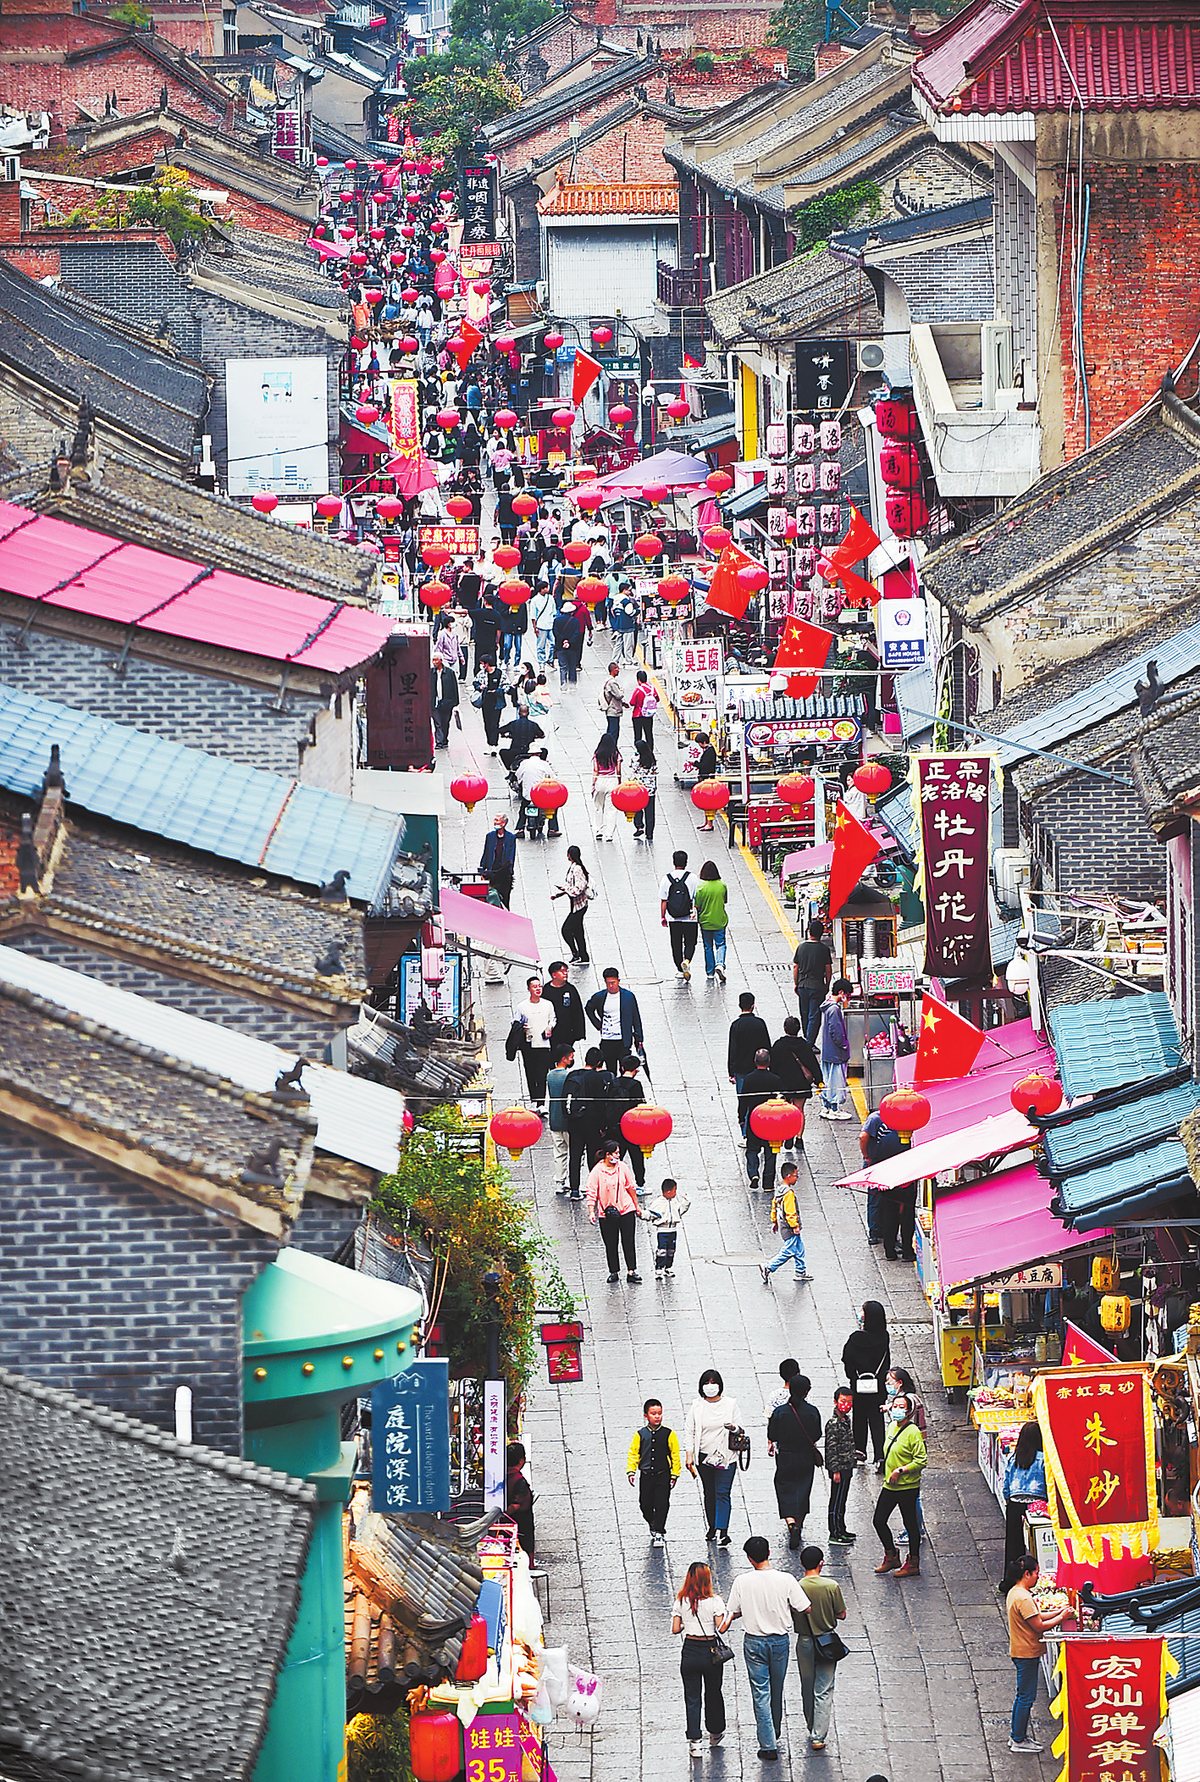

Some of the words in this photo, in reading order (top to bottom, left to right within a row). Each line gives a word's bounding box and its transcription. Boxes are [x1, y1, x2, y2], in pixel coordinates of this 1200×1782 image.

[645, 605, 689, 619] 臭豆腐
[675, 649, 683, 674] 长沙
[685, 647, 719, 673] 臭豆腐
[925, 761, 983, 781] 正宗
[1101, 1264, 1111, 1288] 起名
[1114, 1303, 1124, 1327] 起名
[1055, 1380, 1135, 1400] 赤虹灵砂
[425, 1403, 434, 1421] The
[384, 1404, 412, 1507] 庭院深深
[426, 1442, 434, 1450] is
[424, 1450, 435, 1479] deeply
[1083, 1411, 1121, 1511] 朱砂
[424, 1480, 435, 1505] depth
[1085, 1655, 1147, 1767] 宏灿弹簧
[469, 1726, 515, 1749] 娃娃
